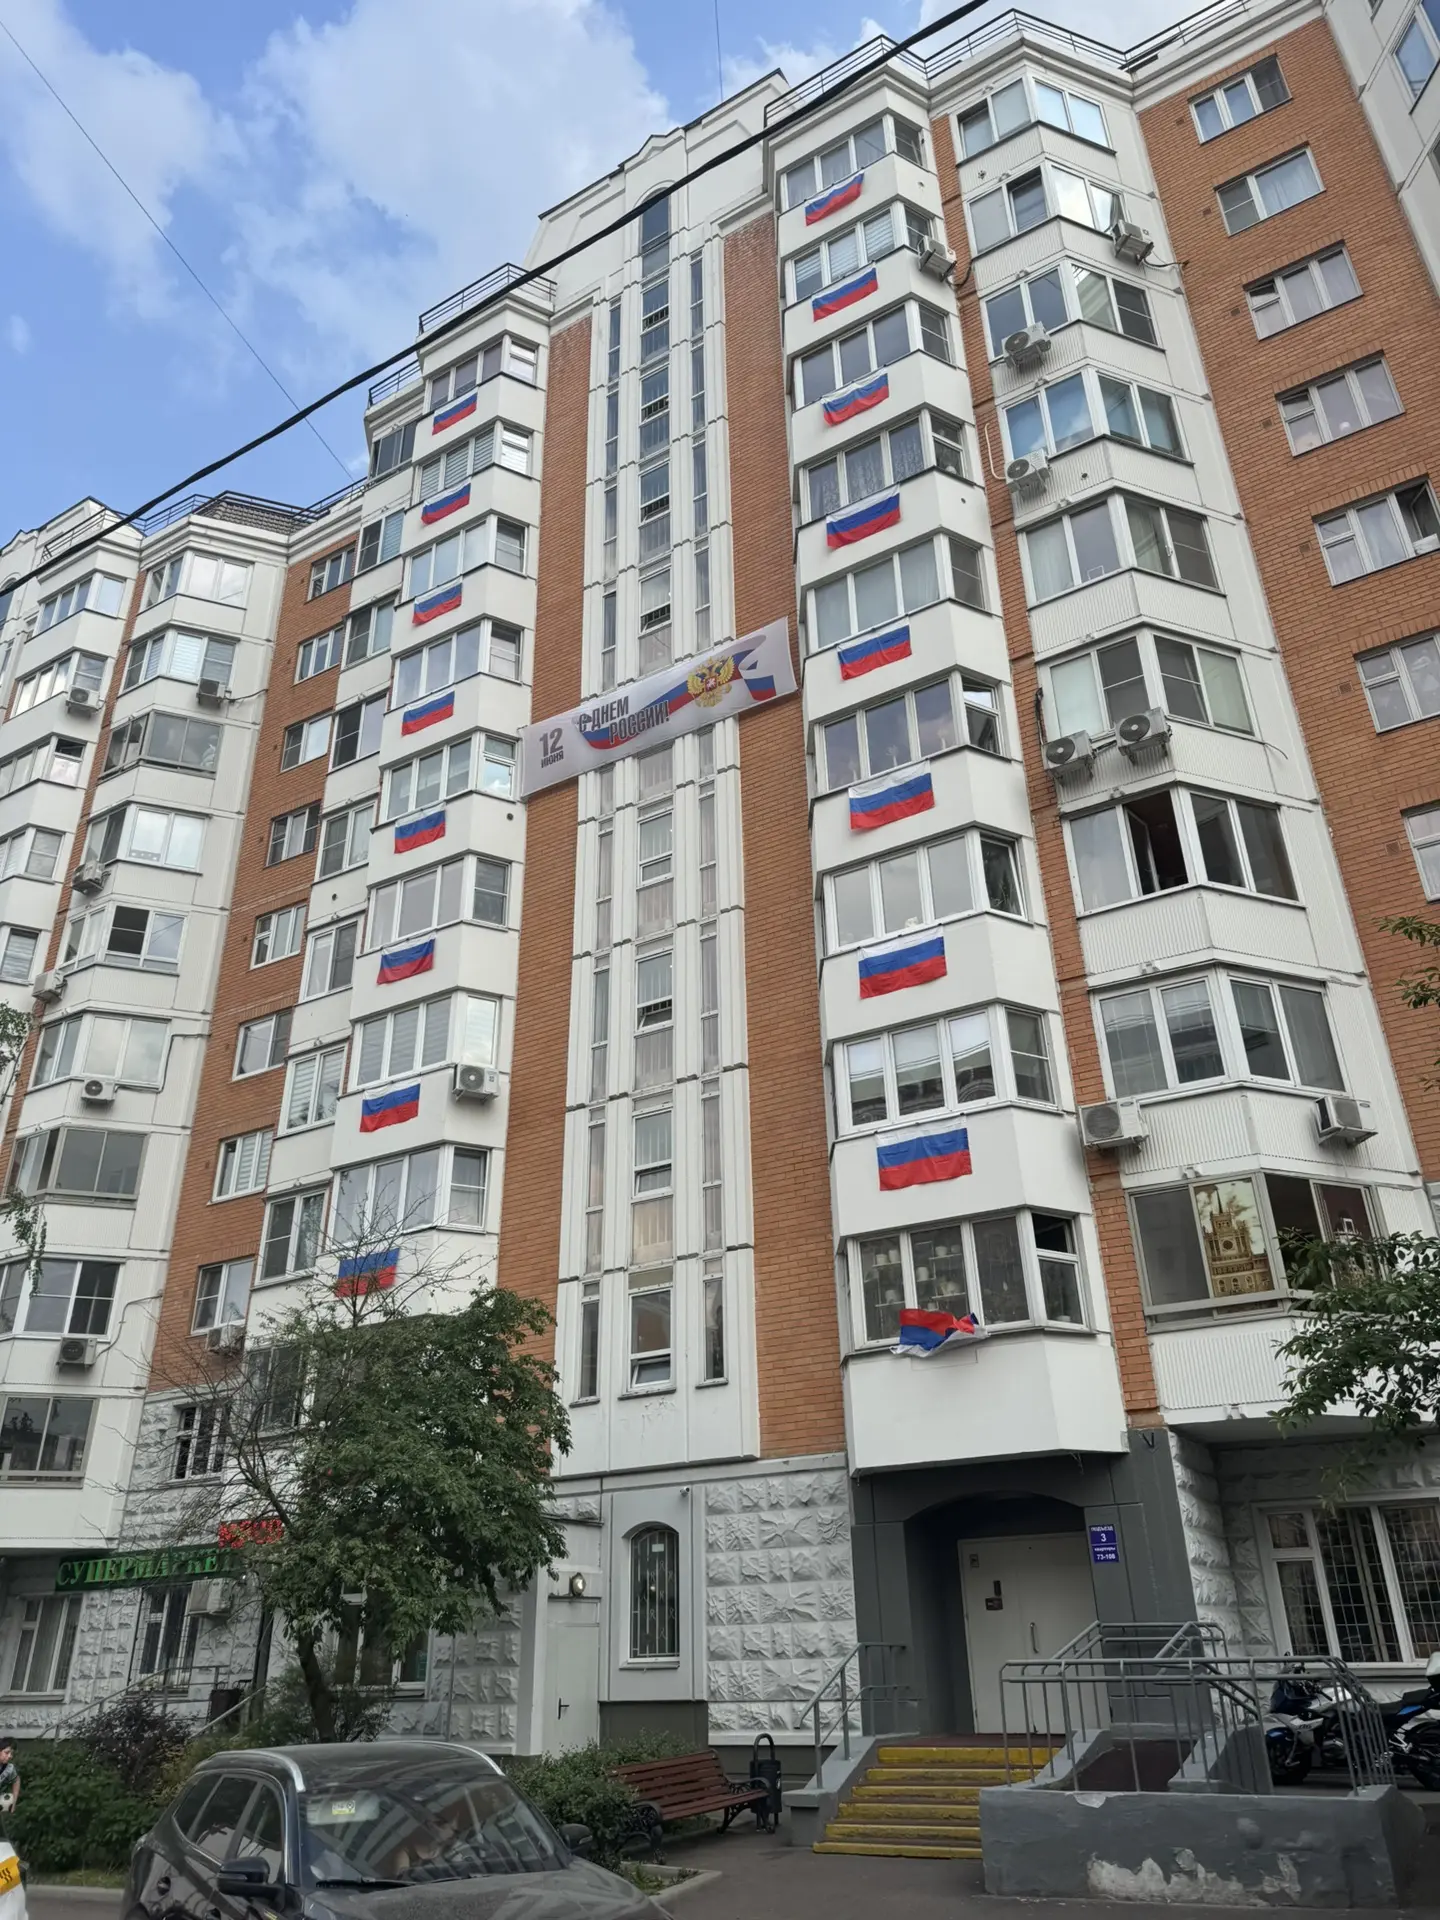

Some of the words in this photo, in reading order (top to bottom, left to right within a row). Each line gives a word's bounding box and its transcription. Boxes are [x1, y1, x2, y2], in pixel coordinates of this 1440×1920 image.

[579, 713, 588, 732] С
[591, 696, 629, 731] ДНЕМ
[609, 700, 670, 744] РОССИИ!
[539, 728, 563, 757] 12
[541, 751, 564, 768] ИЮНЯ
[1100, 1533, 1107, 1542] 3
